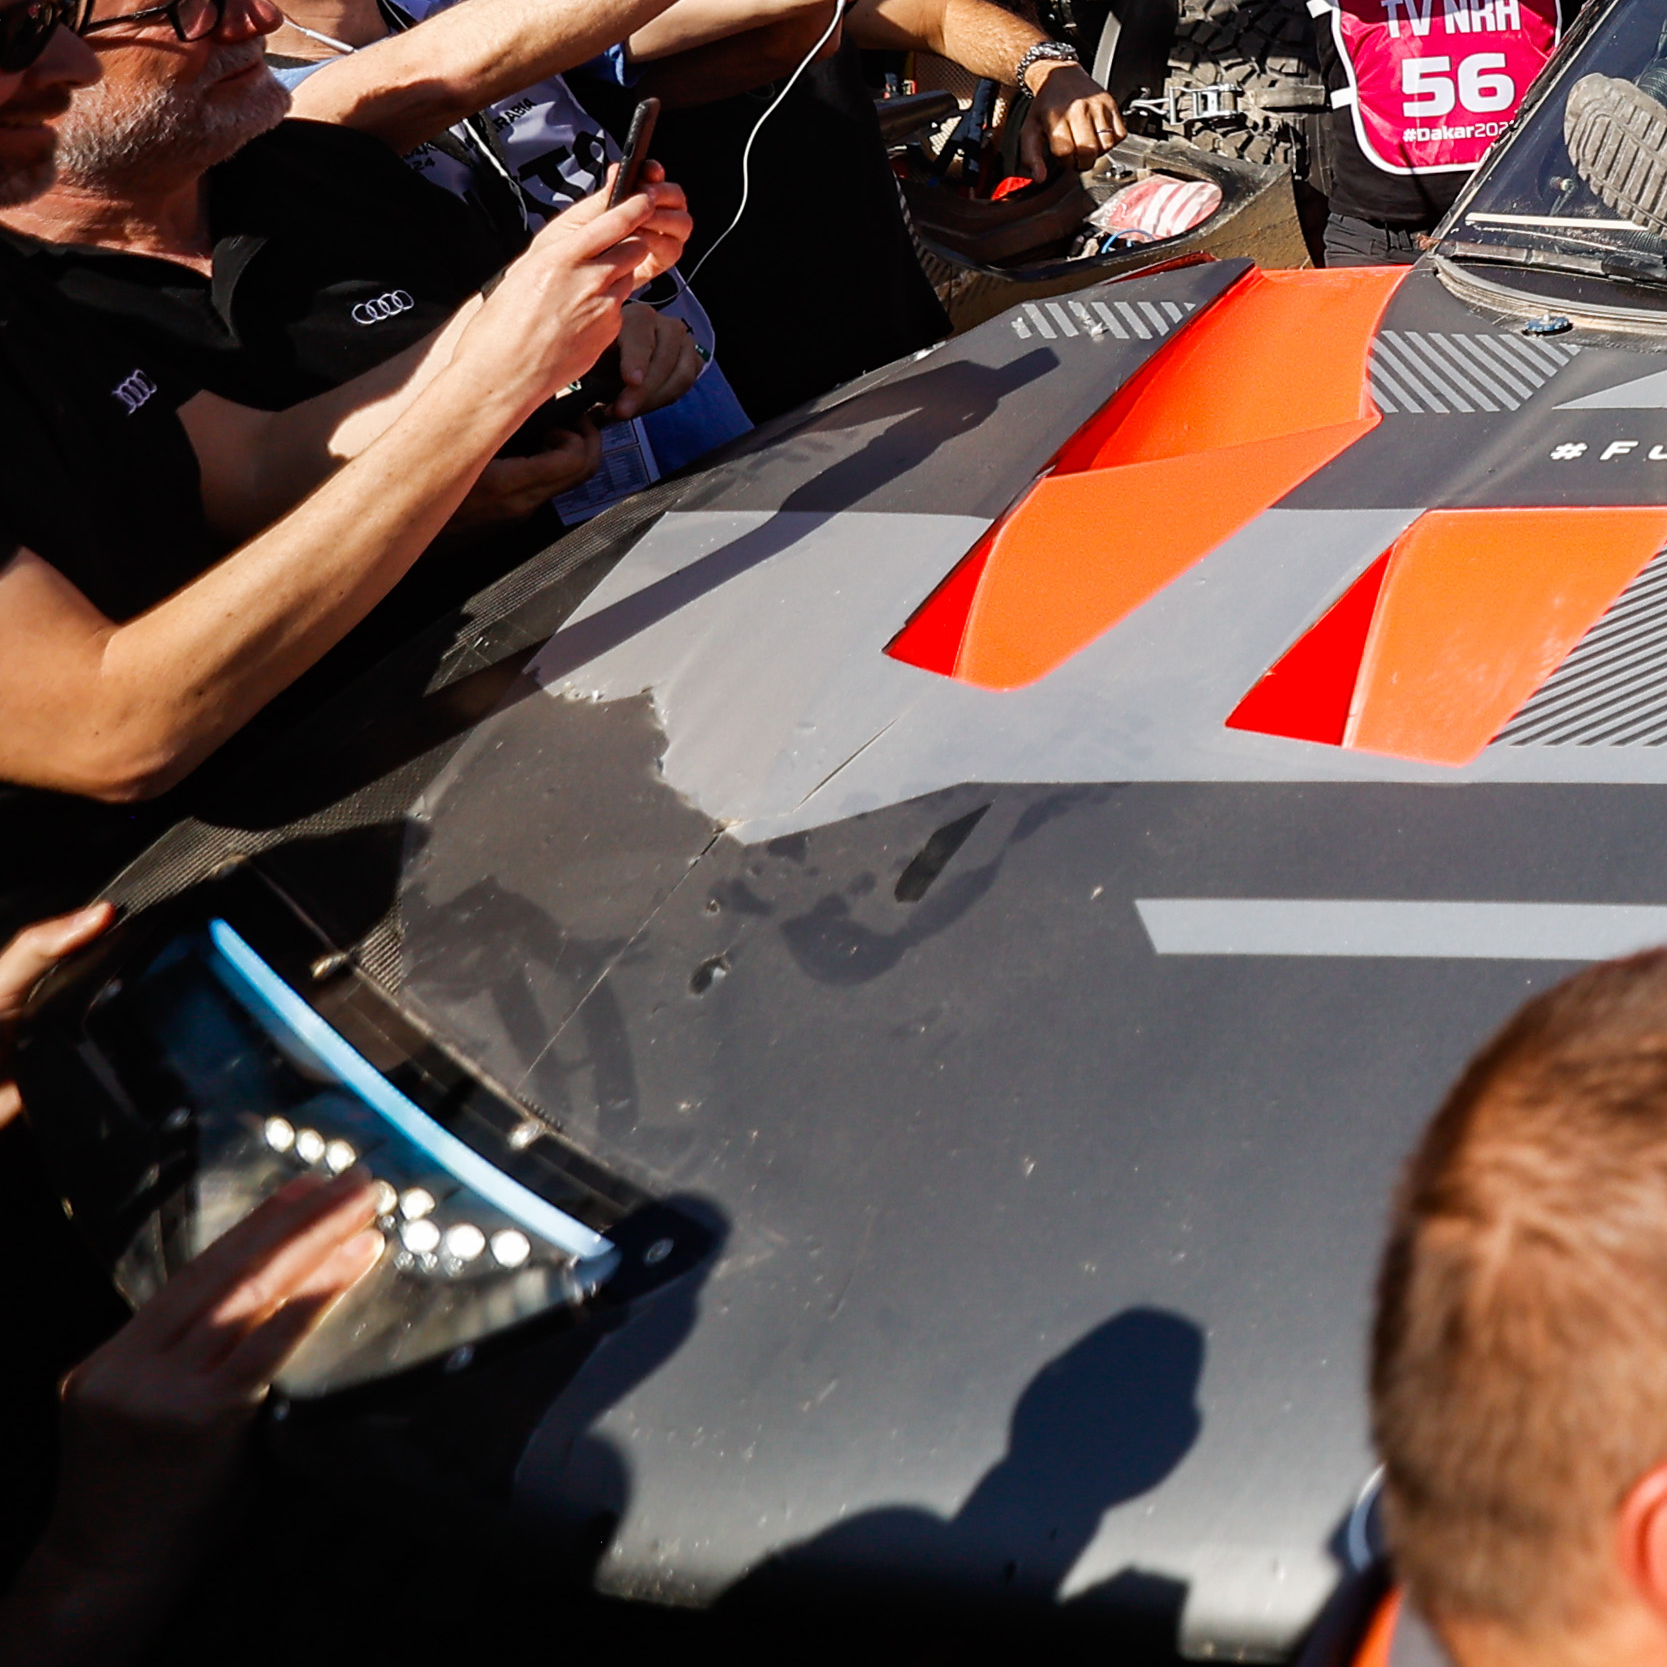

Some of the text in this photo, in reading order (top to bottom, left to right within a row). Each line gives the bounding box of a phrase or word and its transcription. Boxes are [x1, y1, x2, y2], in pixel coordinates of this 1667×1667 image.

[1401, 53, 1515, 117] 56
[492, 97, 537, 133] RABIA
[1403, 119, 1515, 143] #Dakar202
